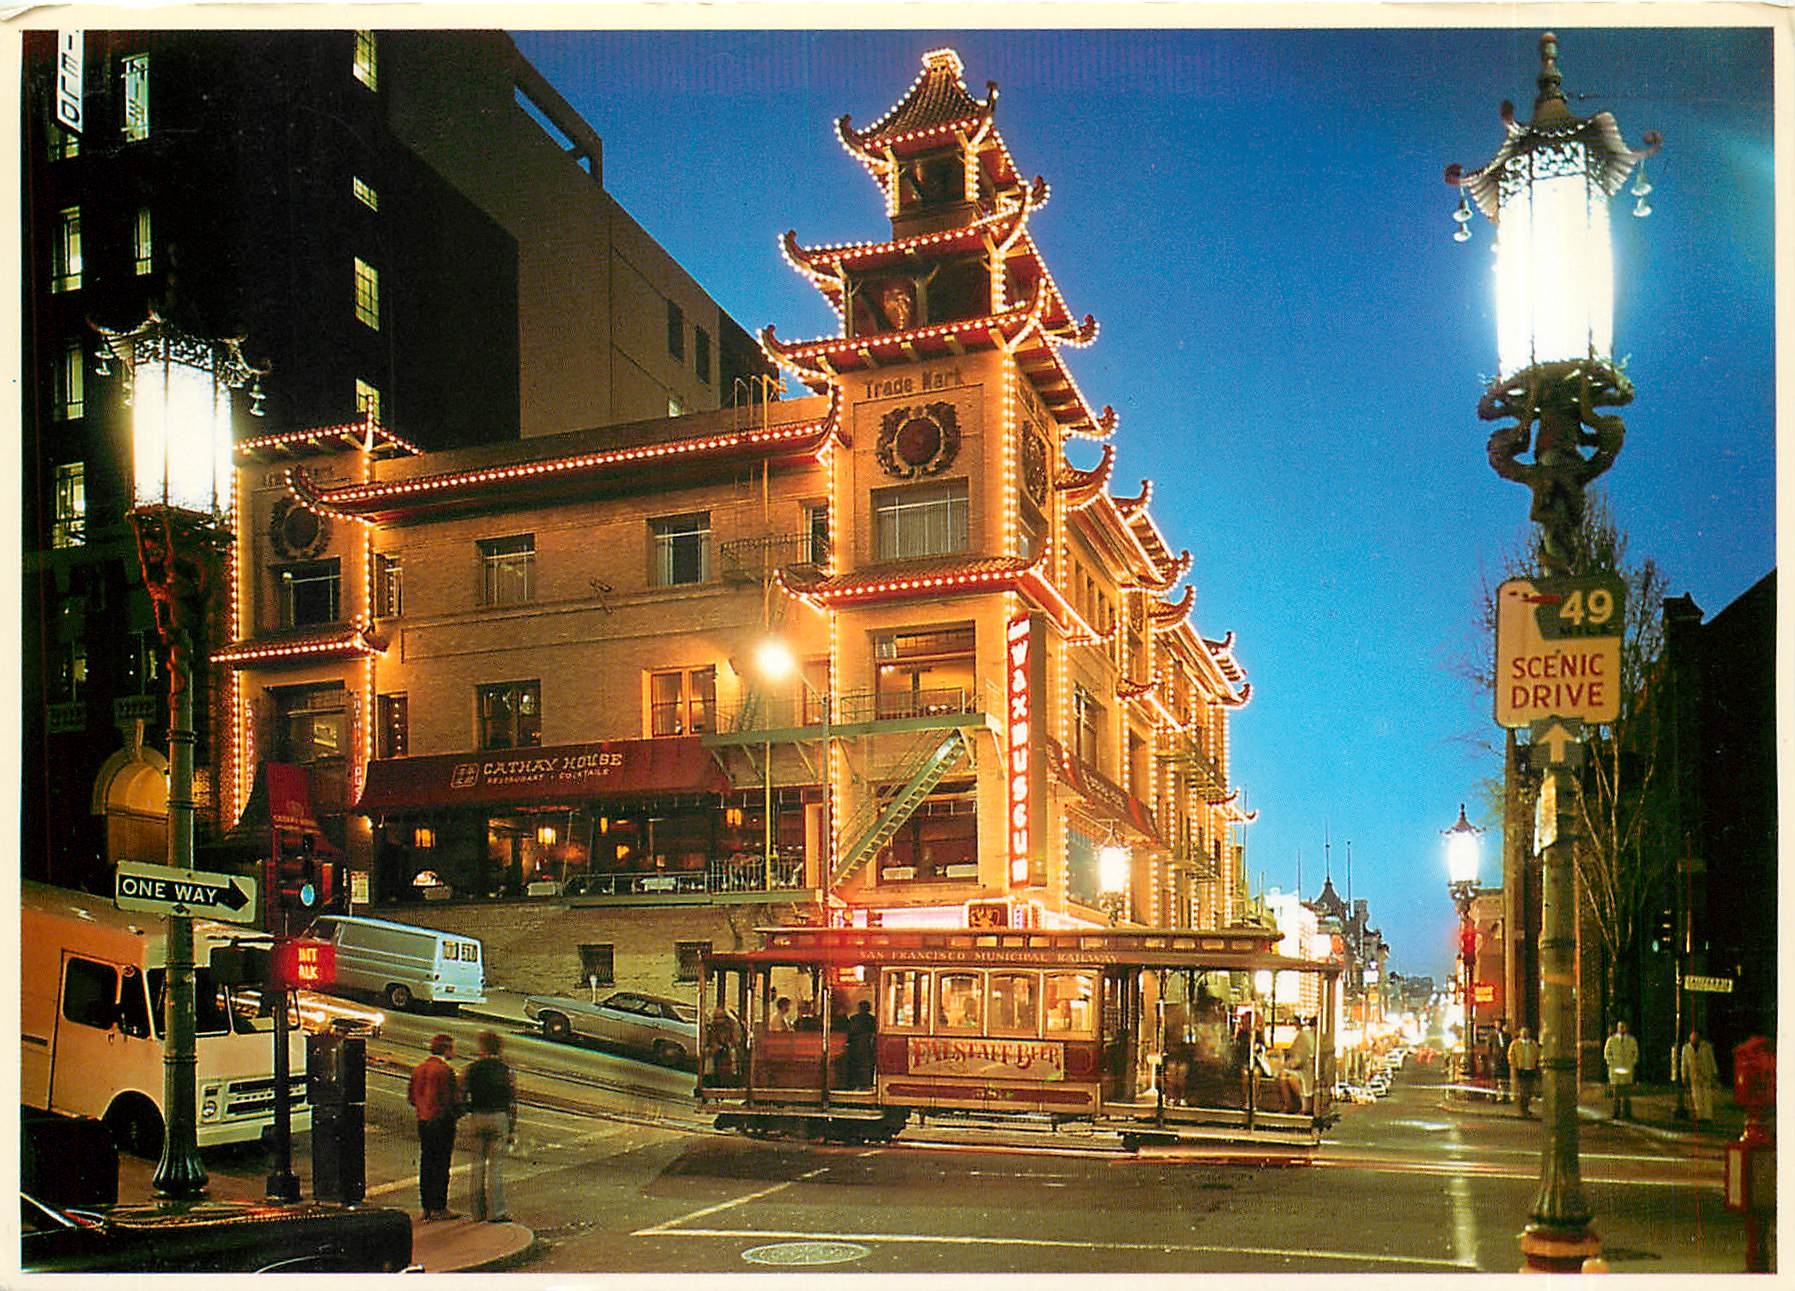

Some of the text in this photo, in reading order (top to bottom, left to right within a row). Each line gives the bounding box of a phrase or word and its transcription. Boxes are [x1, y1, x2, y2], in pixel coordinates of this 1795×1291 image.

[864, 377, 913, 398] Trade
[1560, 589, 1614, 625] 49
[1511, 653, 1605, 679] SCENIC
[1511, 682, 1605, 709] DRIVE
[483, 759, 559, 776] CATHAY
[563, 753, 624, 771] HOUSE
[122, 878, 218, 903] ONE WAY
[860, 950, 1118, 964] SAN FRANCISCO MUNICIPAL RAILWAY
